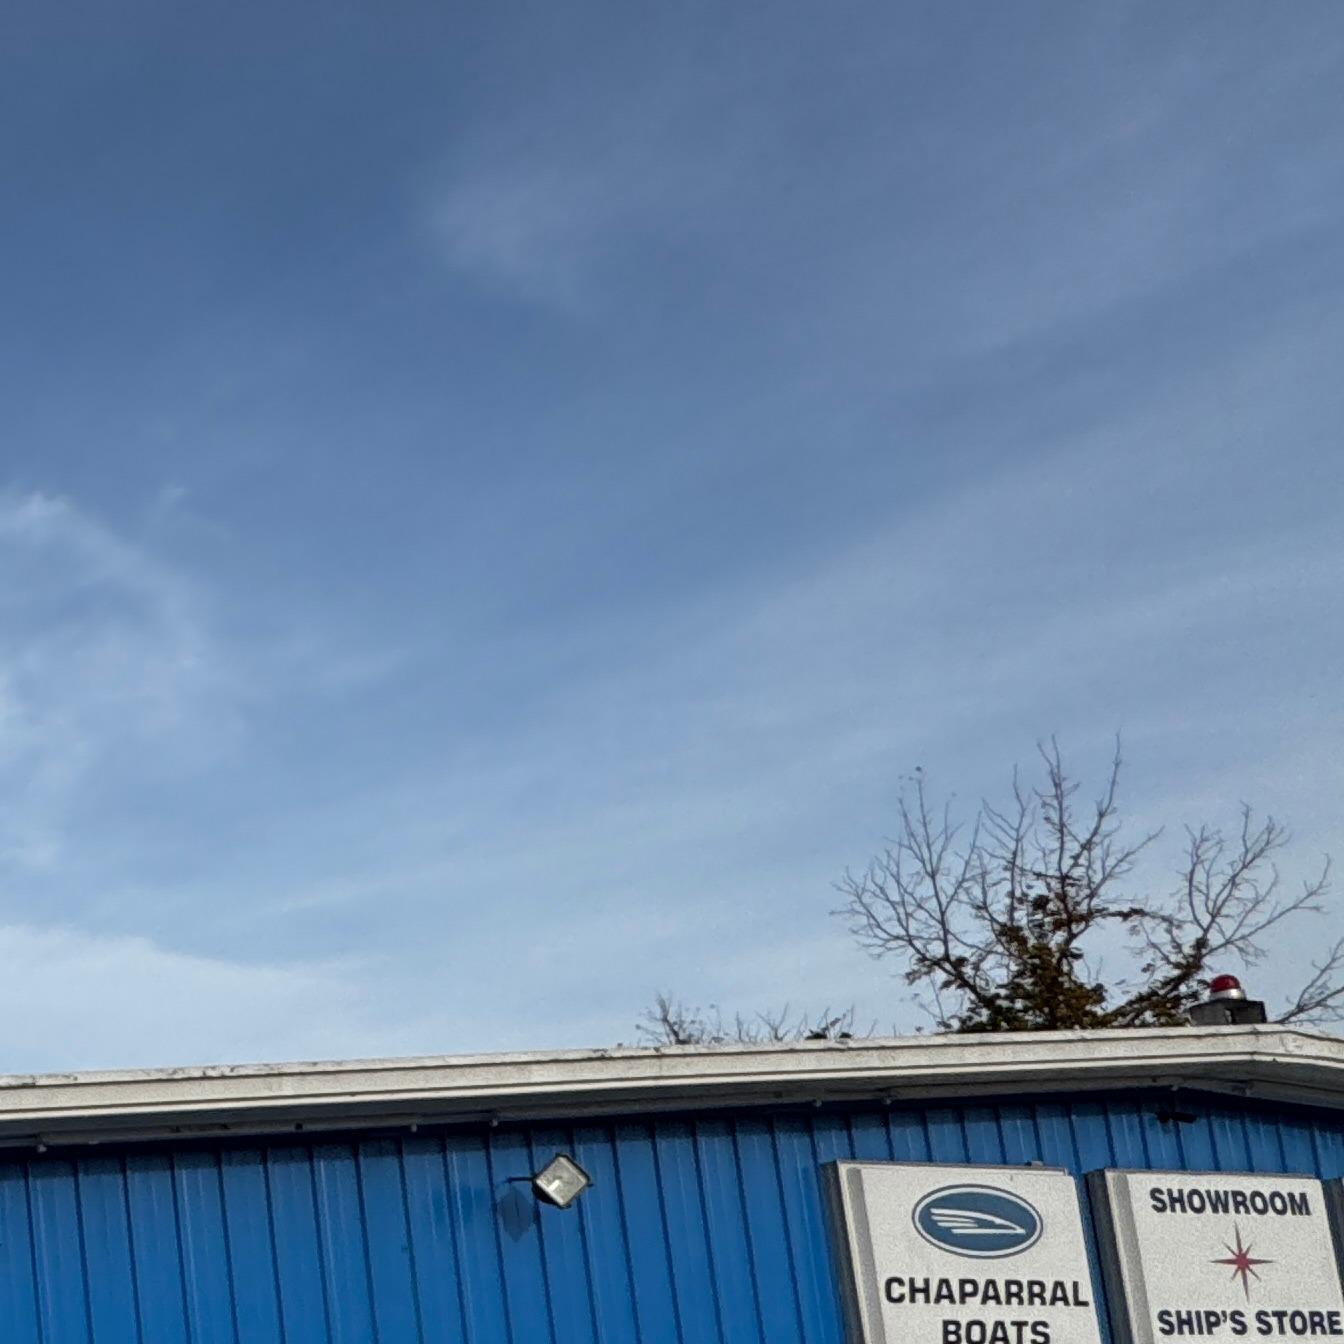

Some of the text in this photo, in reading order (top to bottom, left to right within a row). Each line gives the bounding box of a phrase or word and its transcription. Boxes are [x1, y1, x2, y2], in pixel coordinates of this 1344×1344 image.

[1150, 1188, 1311, 1216] SHOWROOM
[885, 1276, 1090, 1308] CHAPARRAL
[1158, 1310, 1343, 1336] SHIP'S STORE
